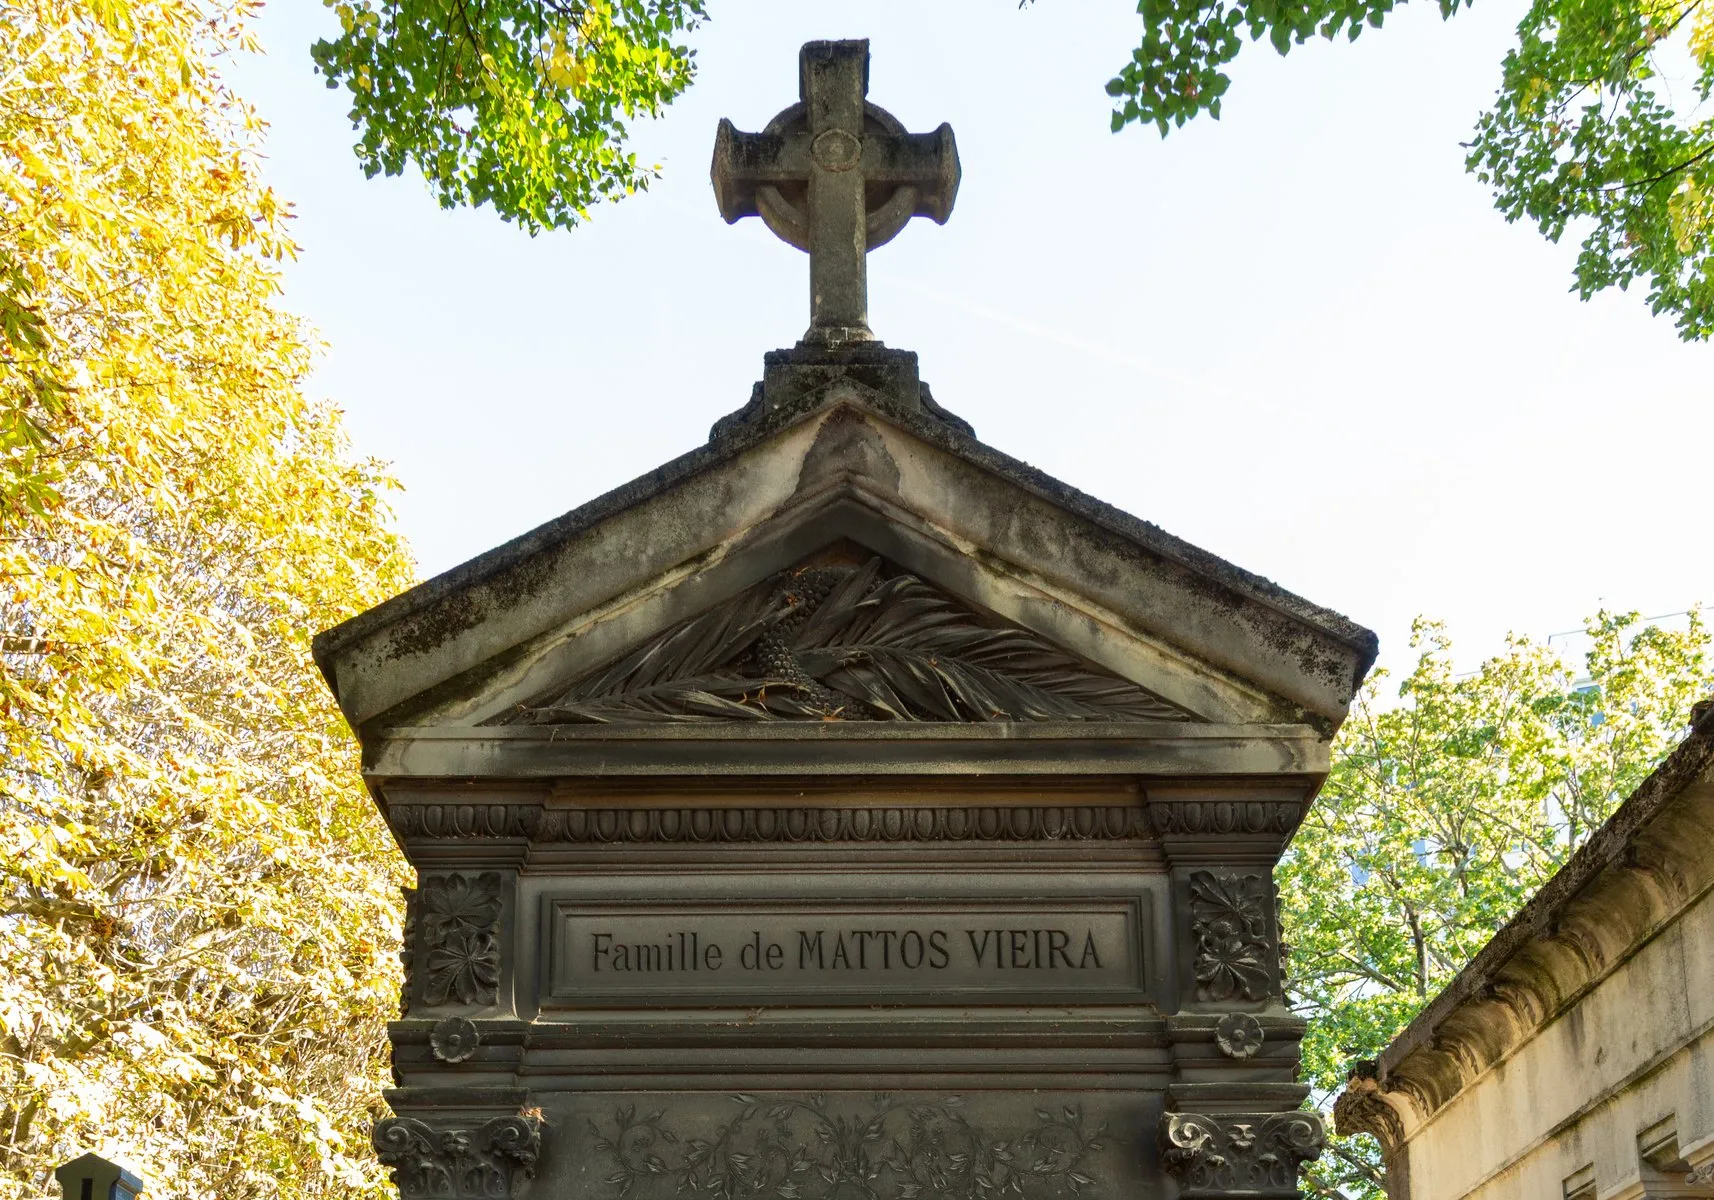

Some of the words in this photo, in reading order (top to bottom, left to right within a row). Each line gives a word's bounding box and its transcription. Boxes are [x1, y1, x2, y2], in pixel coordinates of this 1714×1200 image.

[591, 932, 723, 972] Famille
[740, 931, 785, 971] de
[797, 930, 950, 970] MATTOS
[964, 928, 1103, 970] VIEIRA
